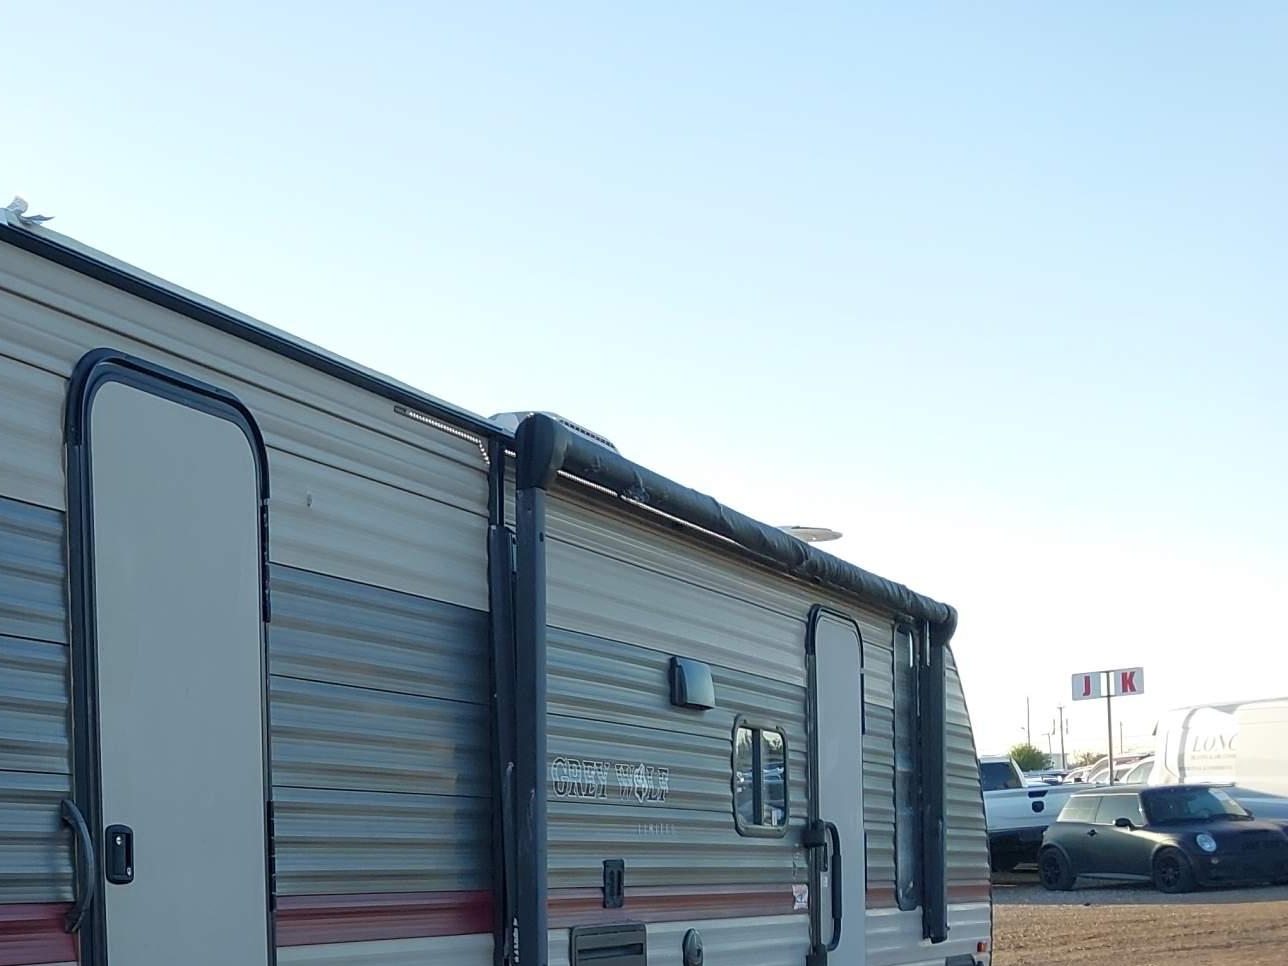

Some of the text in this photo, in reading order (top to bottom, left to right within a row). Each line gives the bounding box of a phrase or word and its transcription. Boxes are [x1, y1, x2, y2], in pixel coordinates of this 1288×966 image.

[1082, 671, 1137, 697] J K
[551, 756, 610, 800] GREY
